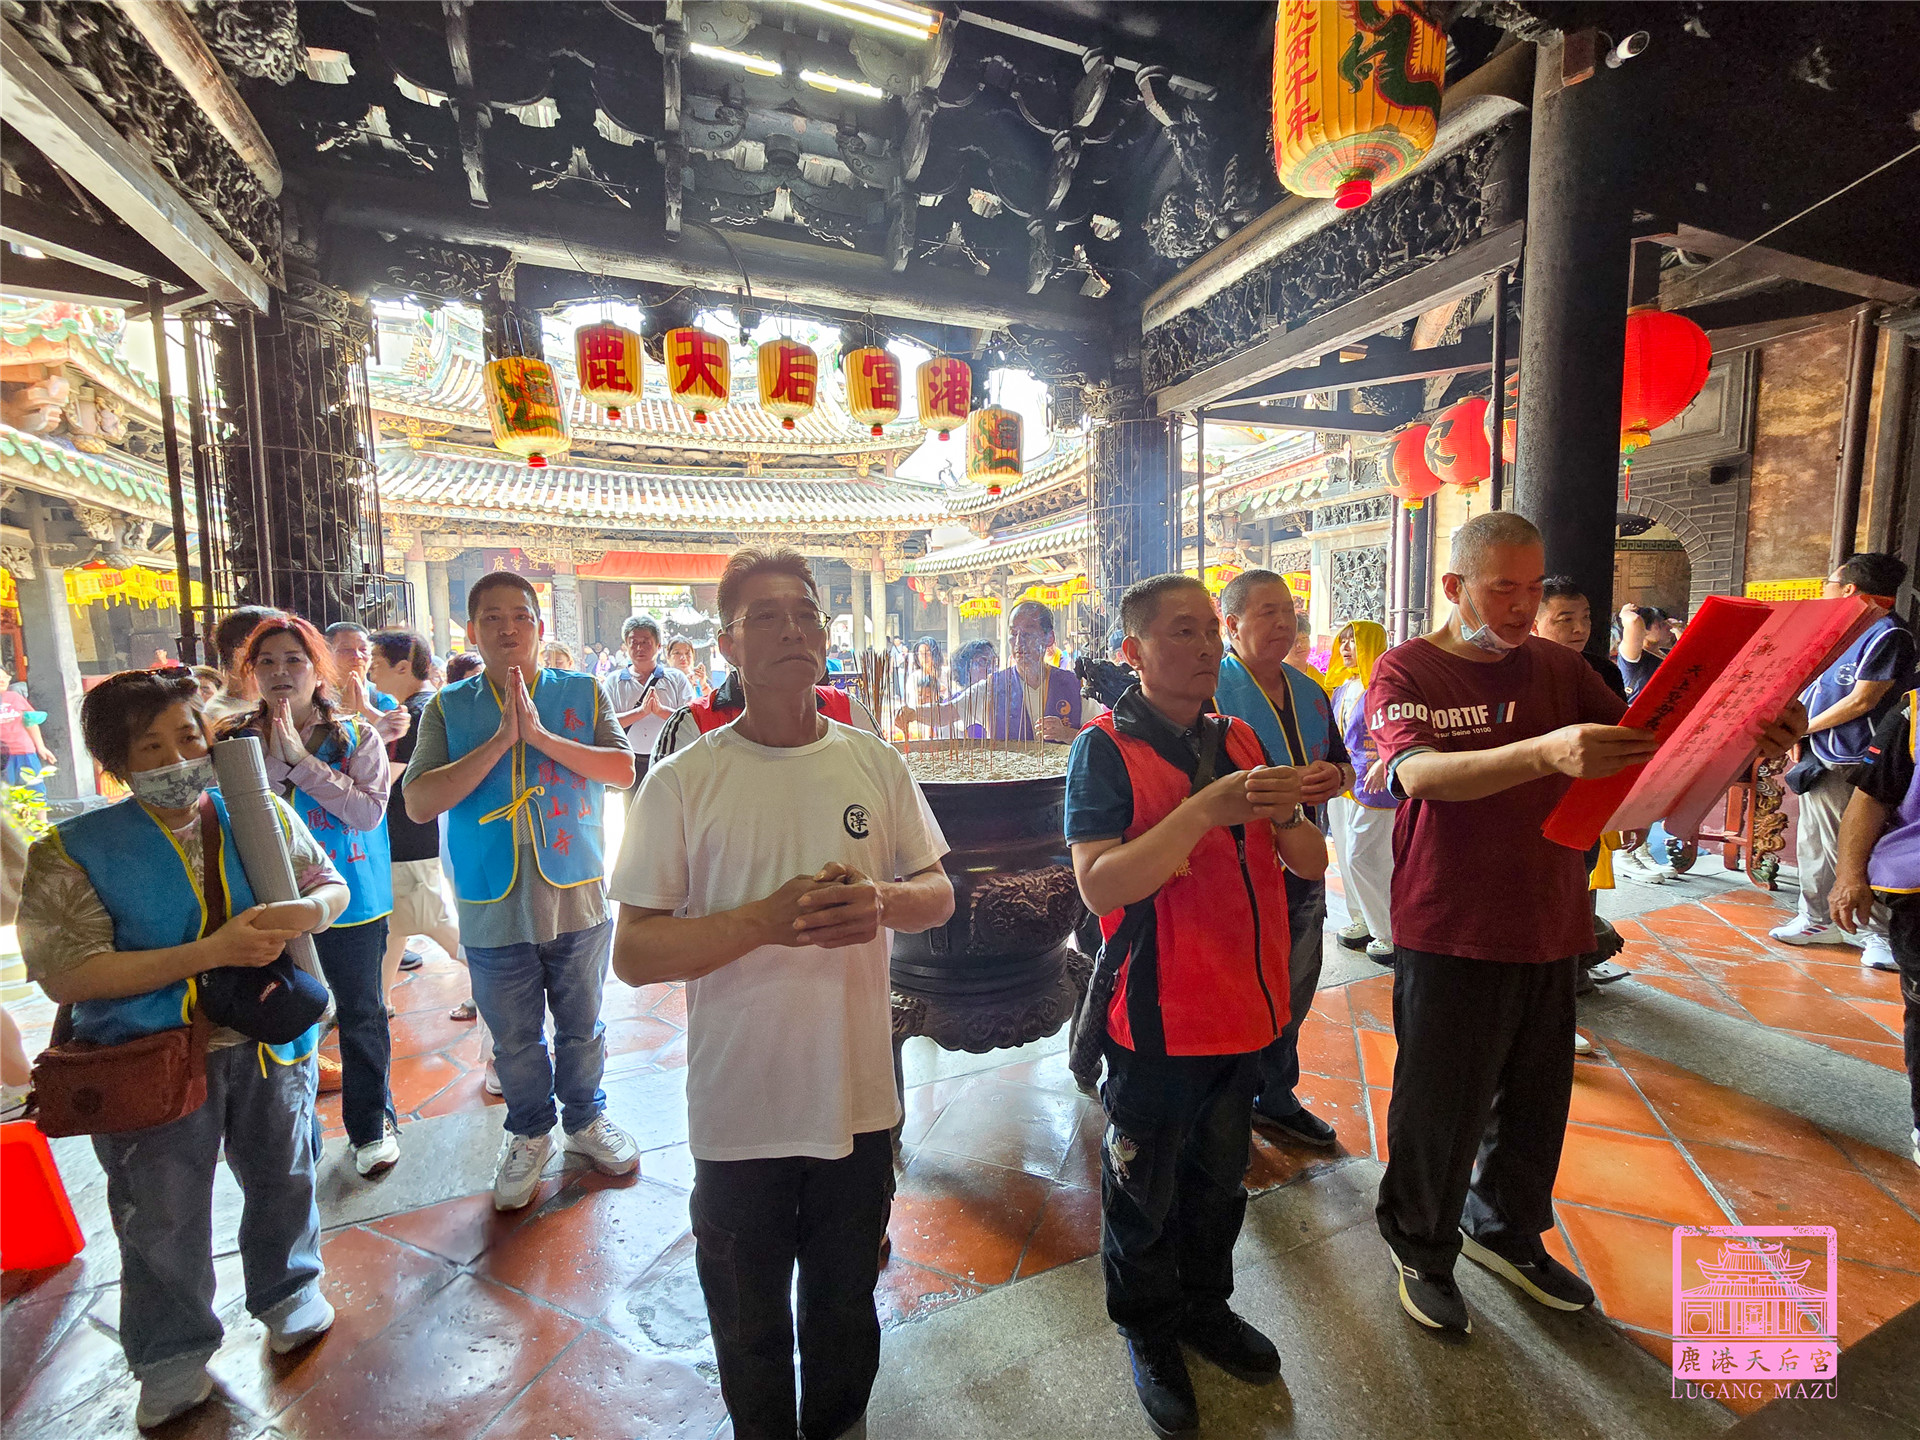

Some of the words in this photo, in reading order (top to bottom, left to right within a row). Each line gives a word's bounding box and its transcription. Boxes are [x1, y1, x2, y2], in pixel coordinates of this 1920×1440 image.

[673, 331, 728, 399] 天
[770, 345, 818, 403] 后
[862, 354, 901, 410] 宮
[928, 361, 969, 417] 港
[1370, 708, 1385, 730] LE
[1387, 702, 1428, 722] COQ
[1451, 729, 1471, 737] Seine
[1472, 726, 1492, 734] 10100
